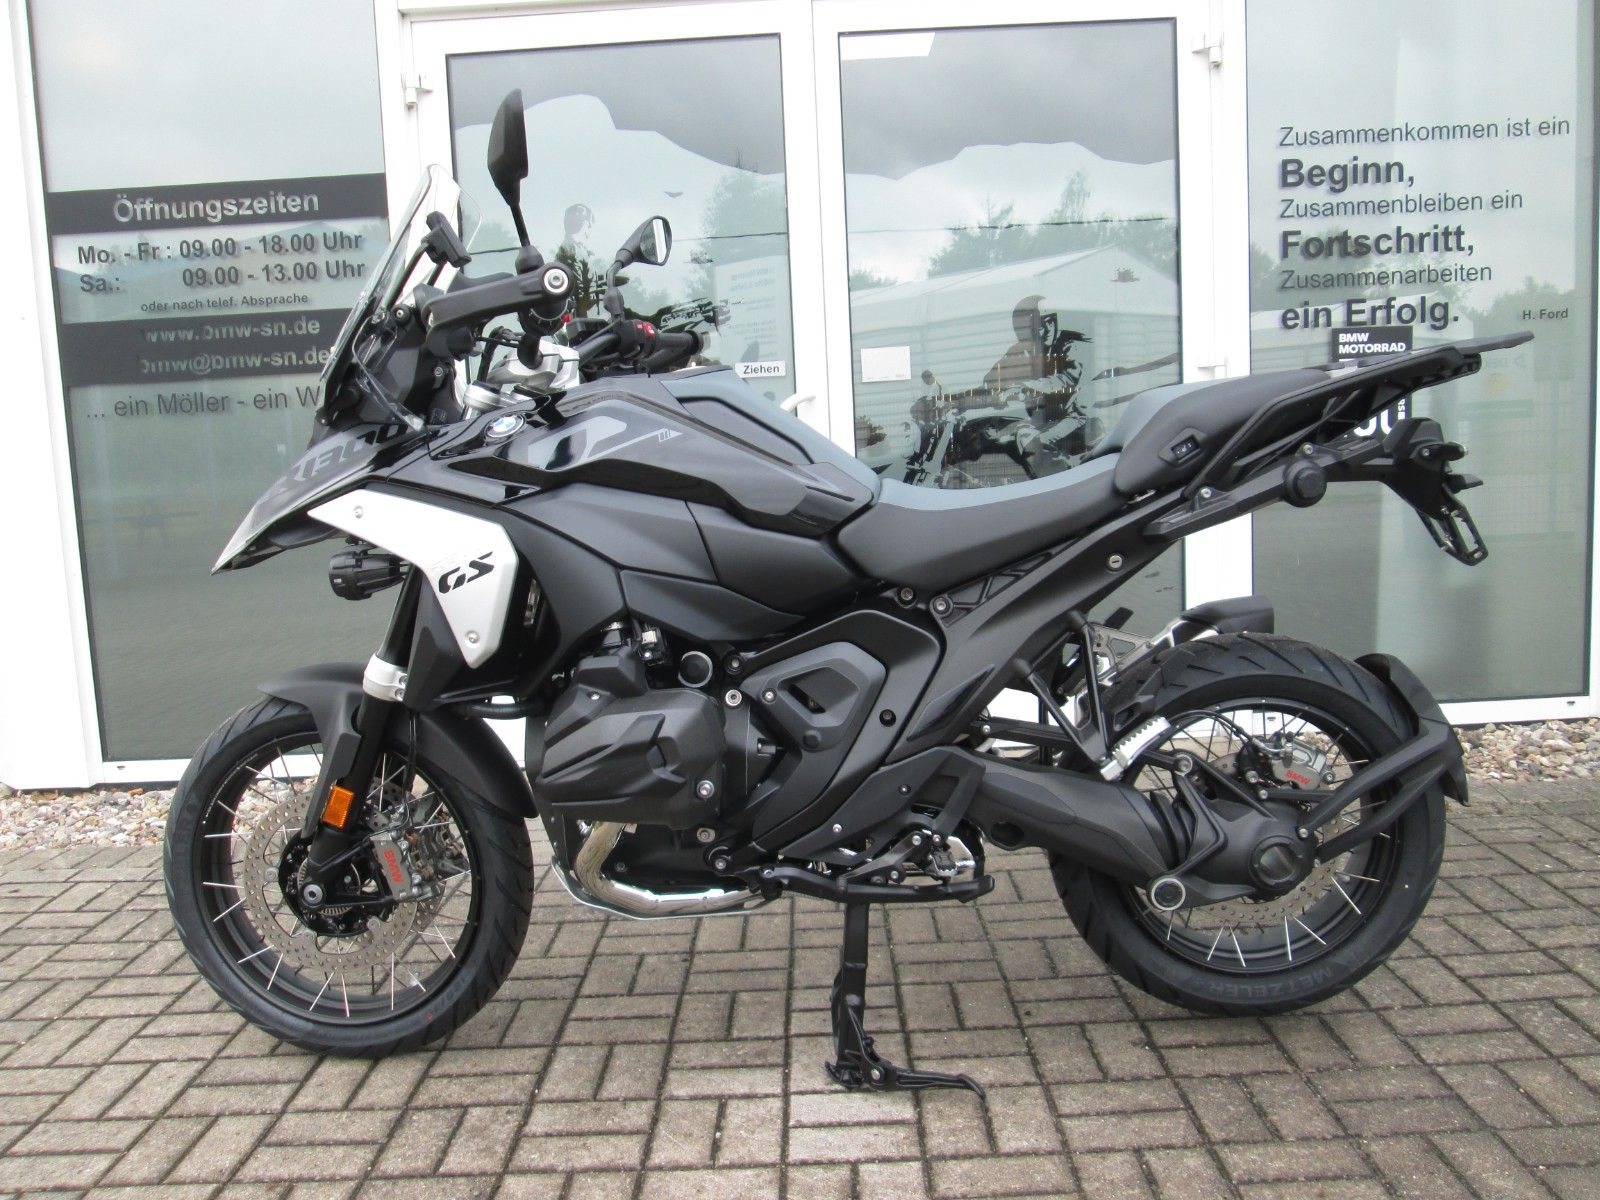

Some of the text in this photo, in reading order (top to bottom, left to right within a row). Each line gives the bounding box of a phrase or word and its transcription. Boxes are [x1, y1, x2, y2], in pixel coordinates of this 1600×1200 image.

[1280, 116, 1570, 147] Zusammenkommen ist ein
[1280, 156, 1415, 193] Beginn,
[113, 190, 319, 223] Öffnungszeiten
[1280, 190, 1523, 218] Zusammenbleiben ein
[78, 245, 116, 264] Mo.
[180, 238, 236, 258] 09.00
[259, 232, 315, 254] 18.00
[323, 230, 362, 250] Uhr
[1281, 225, 1474, 259] Fortschritt,
[80, 274, 120, 292] Sa.:
[182, 266, 239, 287] 09.00
[262, 261, 318, 282] 13.00
[326, 259, 365, 279] Uhr
[1281, 264, 1492, 290] Zusammenarbeiten
[141, 293, 308, 312] oder nach telef. Absprache
[1281, 297, 1459, 331] ein Erfolg.
[1522, 308, 1569, 320] H. Ford
[1339, 332, 1369, 342] BMW
[1339, 342, 1406, 354] MOTORRAD
[743, 365, 780, 375] Ziehen
[114, 395, 149, 417] ein
[157, 391, 229, 415] Möller
[253, 388, 288, 409] ein
[438, 550, 495, 594] GS
[1286, 769, 1310, 785] BMW
[383, 849, 404, 884] BMW
